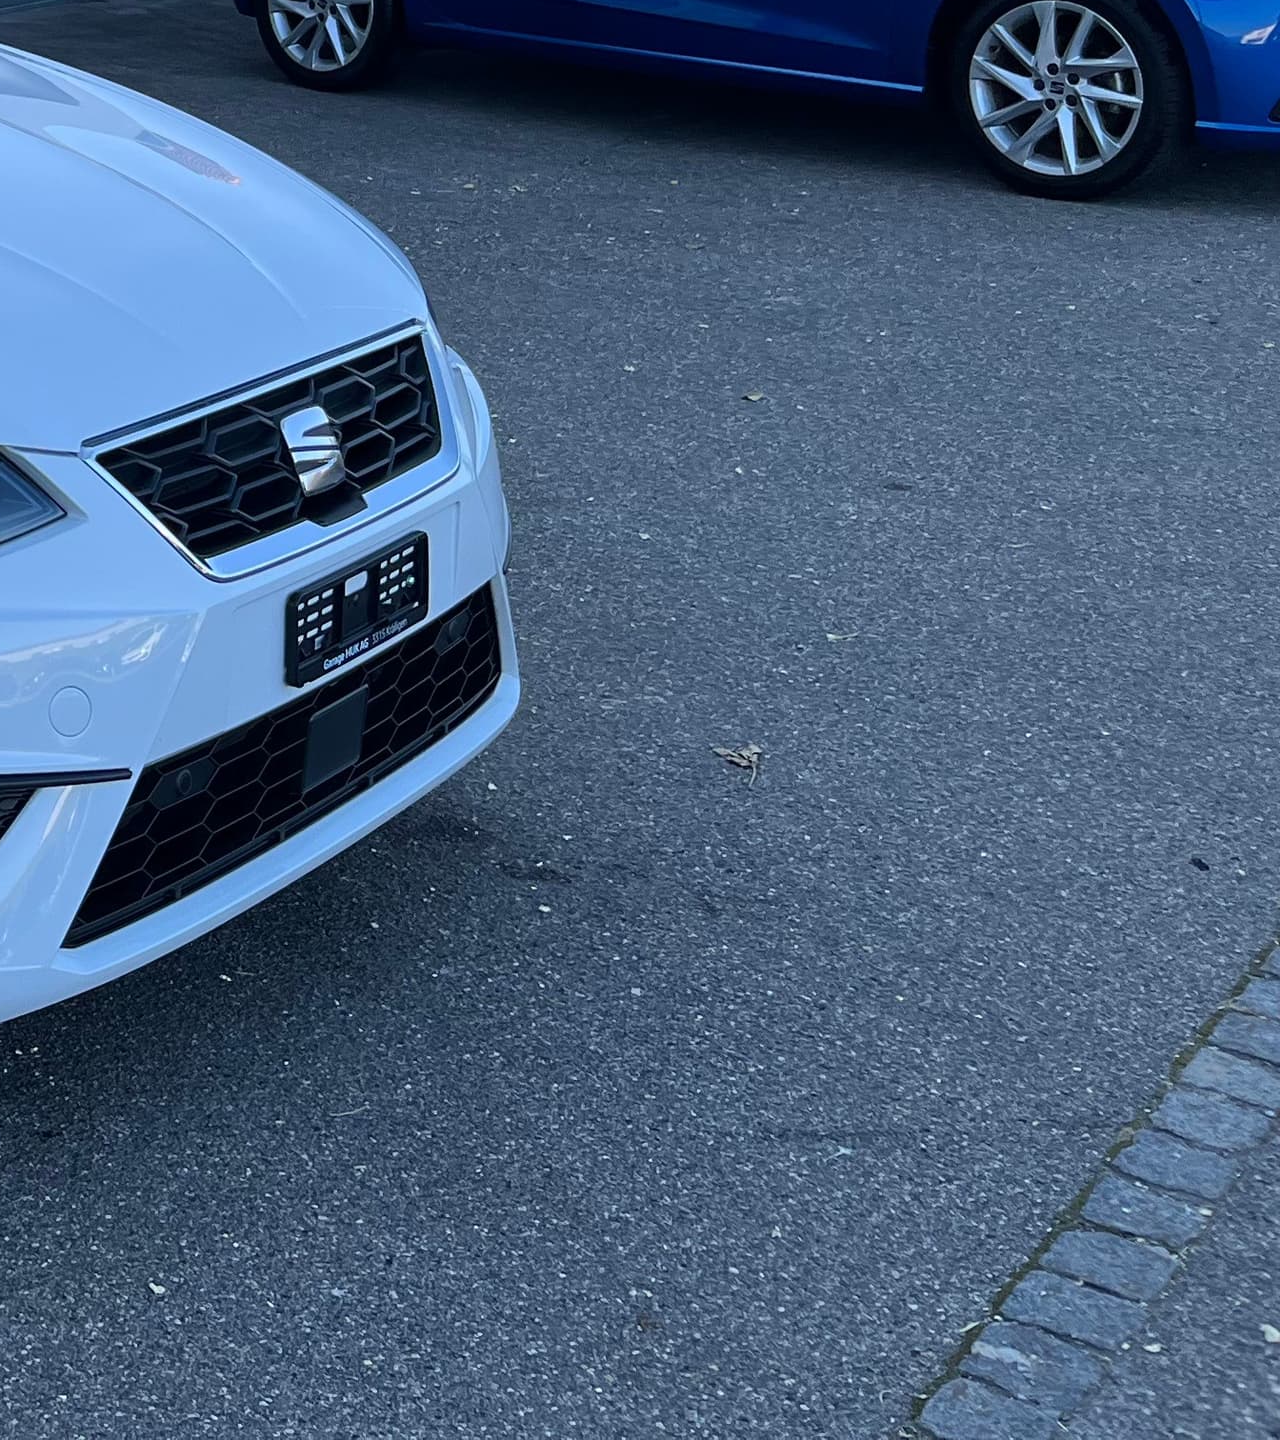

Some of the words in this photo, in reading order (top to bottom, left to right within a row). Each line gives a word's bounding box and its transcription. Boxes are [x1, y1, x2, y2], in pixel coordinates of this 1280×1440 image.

[323, 653, 345, 670] Garage
[345, 642, 360, 658] HUK
[360, 637, 369, 651] AG
